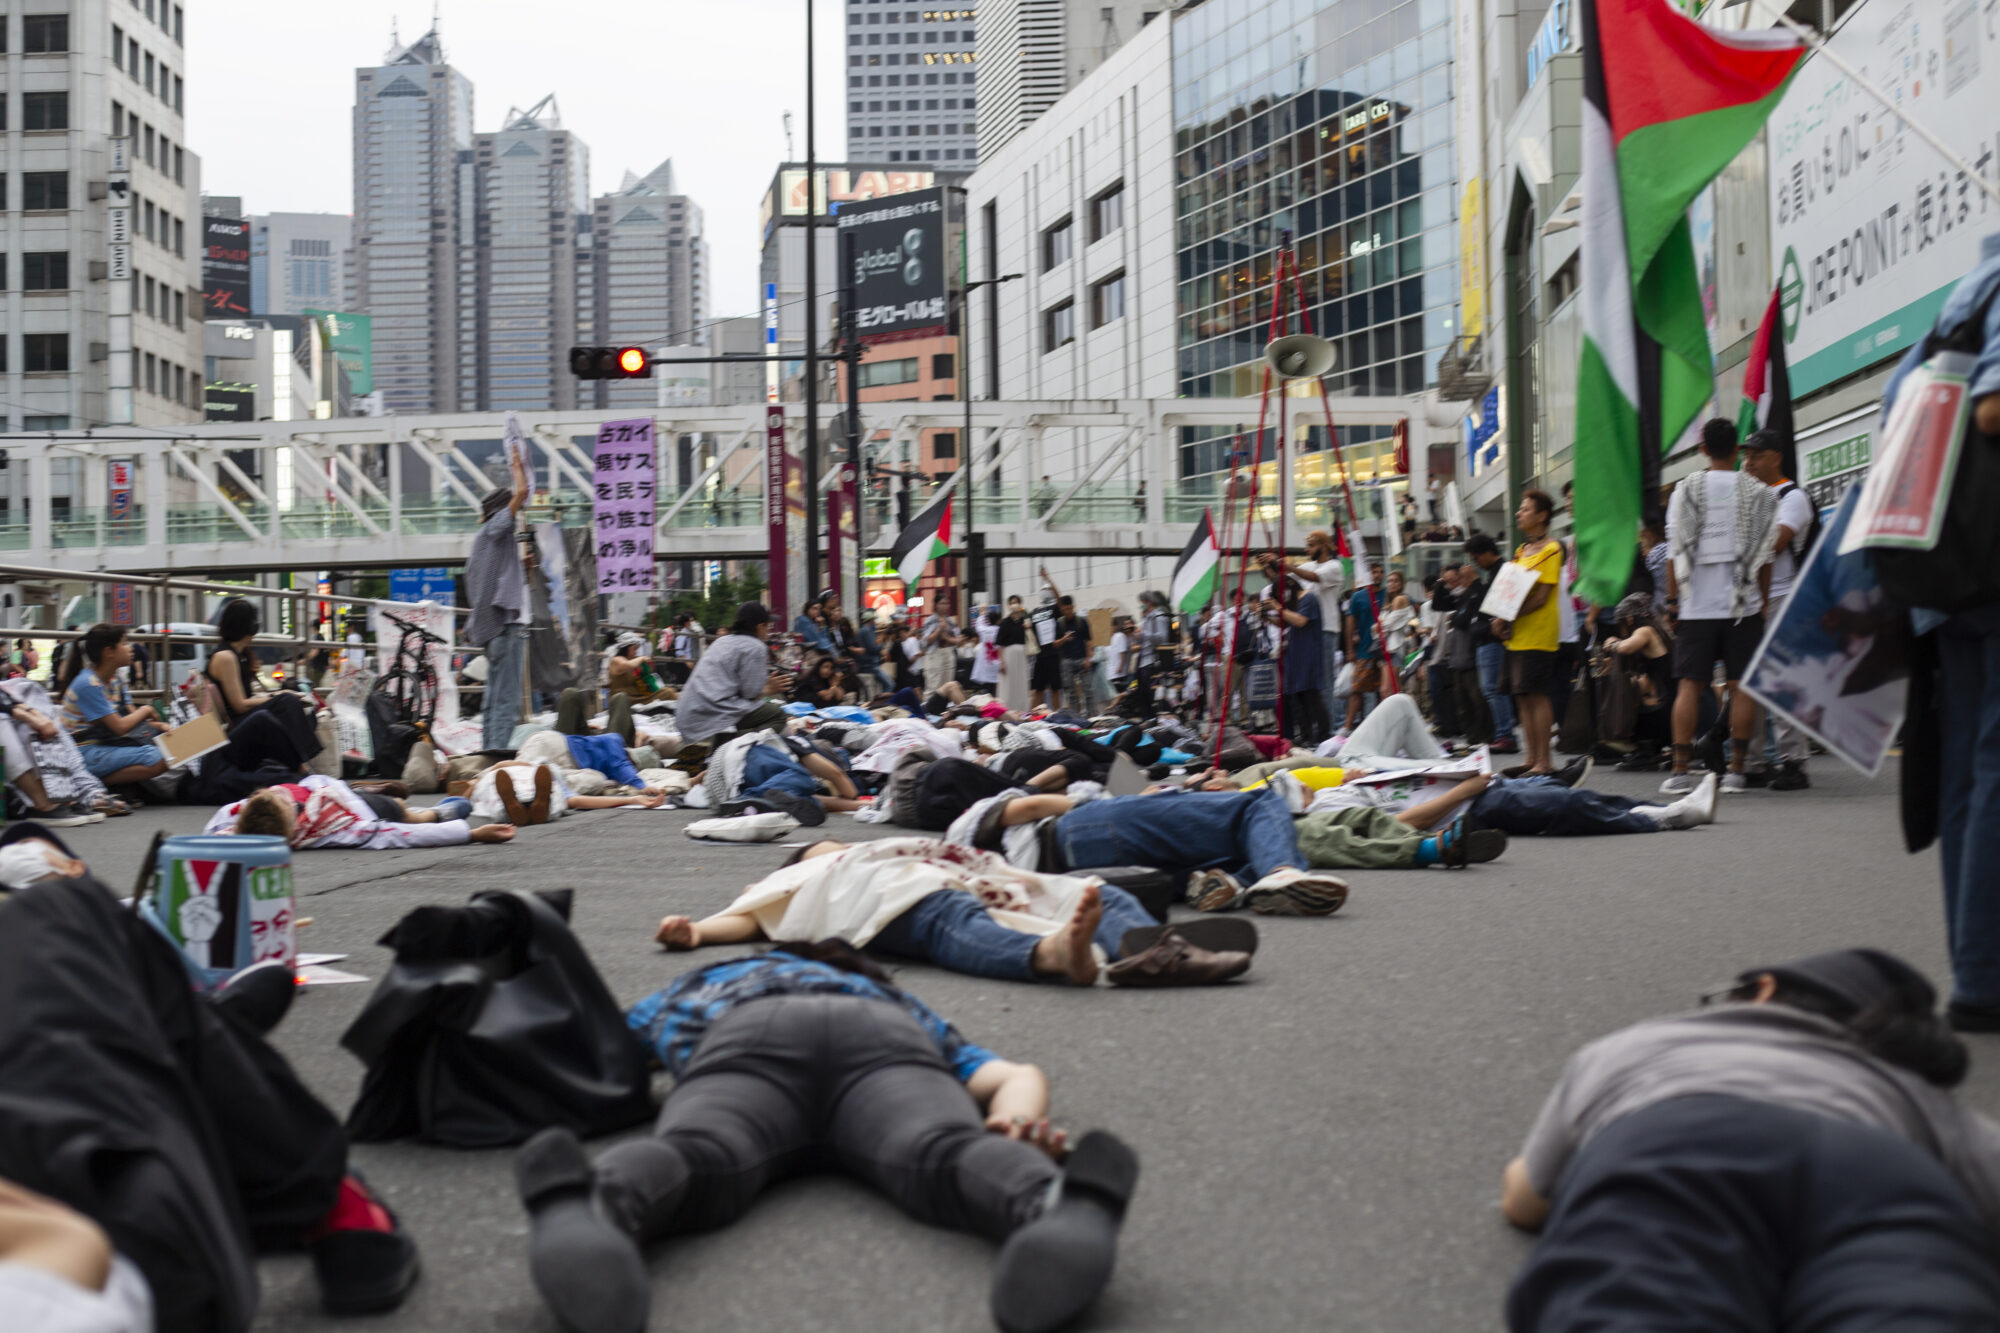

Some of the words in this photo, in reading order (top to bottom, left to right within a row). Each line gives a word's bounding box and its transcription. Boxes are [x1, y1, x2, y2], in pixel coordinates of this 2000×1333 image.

[829, 171, 935, 200] LABI
[225, 326, 255, 341] FPG
[595, 426, 617, 588] 占領をやめよ
[615, 425, 638, 587] ガザ民族浄化
[634, 424, 654, 586] イスラエルは
